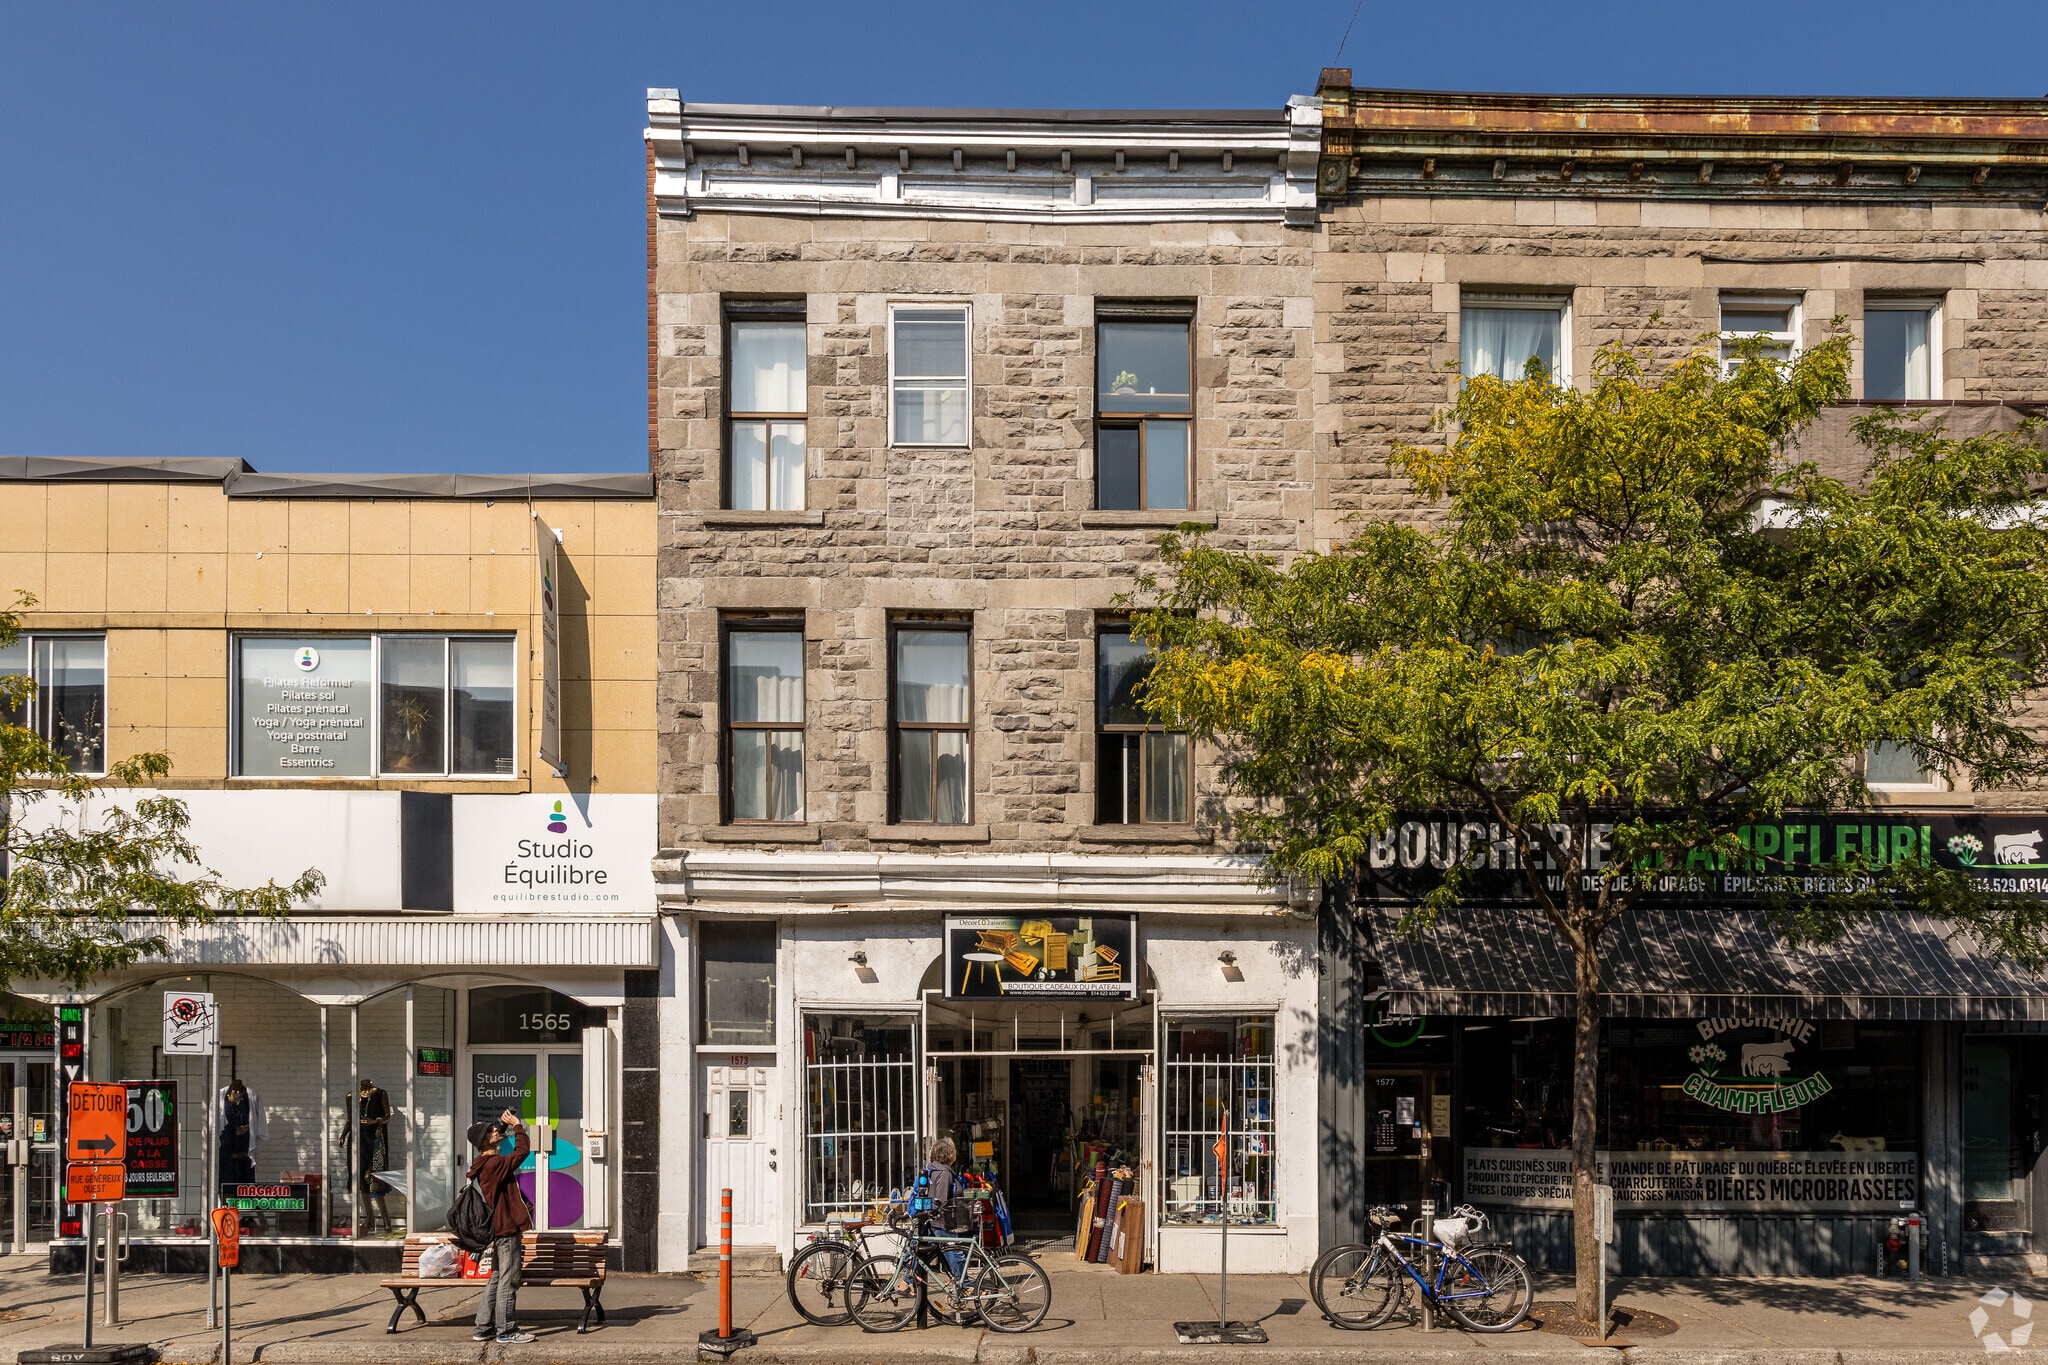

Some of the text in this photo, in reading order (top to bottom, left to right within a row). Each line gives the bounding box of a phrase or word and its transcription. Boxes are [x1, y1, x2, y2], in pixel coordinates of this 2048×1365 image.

[263, 677, 353, 688] Pilates Reformer
[281, 689, 335, 701] Pilates sol
[267, 703, 350, 715] Pilates prénatal
[252, 716, 280, 728] Yoga
[289, 716, 317, 728] Yoga
[318, 716, 364, 728] prénatal
[267, 730, 347, 742] Yoga postnatal
[291, 743, 320, 754] Barre
[280, 756, 335, 767] Essentrics
[517, 839, 593, 859] Studio
[504, 860, 608, 889] Équilibre
[1547, 875, 1606, 891] VIADES
[493, 893, 619, 902] equilibrestudio.com
[519, 1013, 571, 1031] 1565
[67, 1025, 76, 1040] IN
[730, 1055, 749, 1066] 1573
[477, 1072, 517, 1084] Studio
[1375, 1078, 1396, 1087] 1577
[477, 1085, 532, 1100] Équilibre
[1682, 1070, 1833, 1115] CHAMPFLEURI
[73, 1089, 122, 1112] DÉTOUR
[128, 1137, 170, 1146] DE PLUS
[147, 1148, 161, 1158] LA
[130, 1160, 168, 1169] CAISSE
[1467, 1158, 1498, 1171] PLATS
[1499, 1158, 1545, 1173] CUISINÉS
[1546, 1160, 1569, 1173] SUR
[1610, 1161, 1654, 1175] VIANDE
[1656, 1161, 1672, 1175] DE
[1738, 1161, 1755, 1175] DU
[1756, 1159, 1803, 1175] QUÉBEC
[1804, 1159, 1847, 1175] ÉLEVÉE
[1849, 1161, 1865, 1175] EN
[1867, 1159, 1915, 1175] LIBERTÉ
[71, 1172, 121, 1184] RUE GÉNÉREUX
[128, 1172, 146, 1183] JOURS
[146, 1171, 176, 1183] SEULEMENT
[1467, 1172, 1512, 1184] PRODUITS
[1610, 1177, 1693, 1189] CHARCUTERIES
[1695, 1177, 1703, 1189] &
[83, 1183, 106, 1194] OUEST
[236, 1184, 292, 1197] MAGASIN
[1467, 1183, 1574, 1200] ÉPICES COUPES SPÉCIA
[1612, 1190, 1704, 1201] SAUCISSES MAISON
[226, 1197, 305, 1210] TEMPORAIRE
